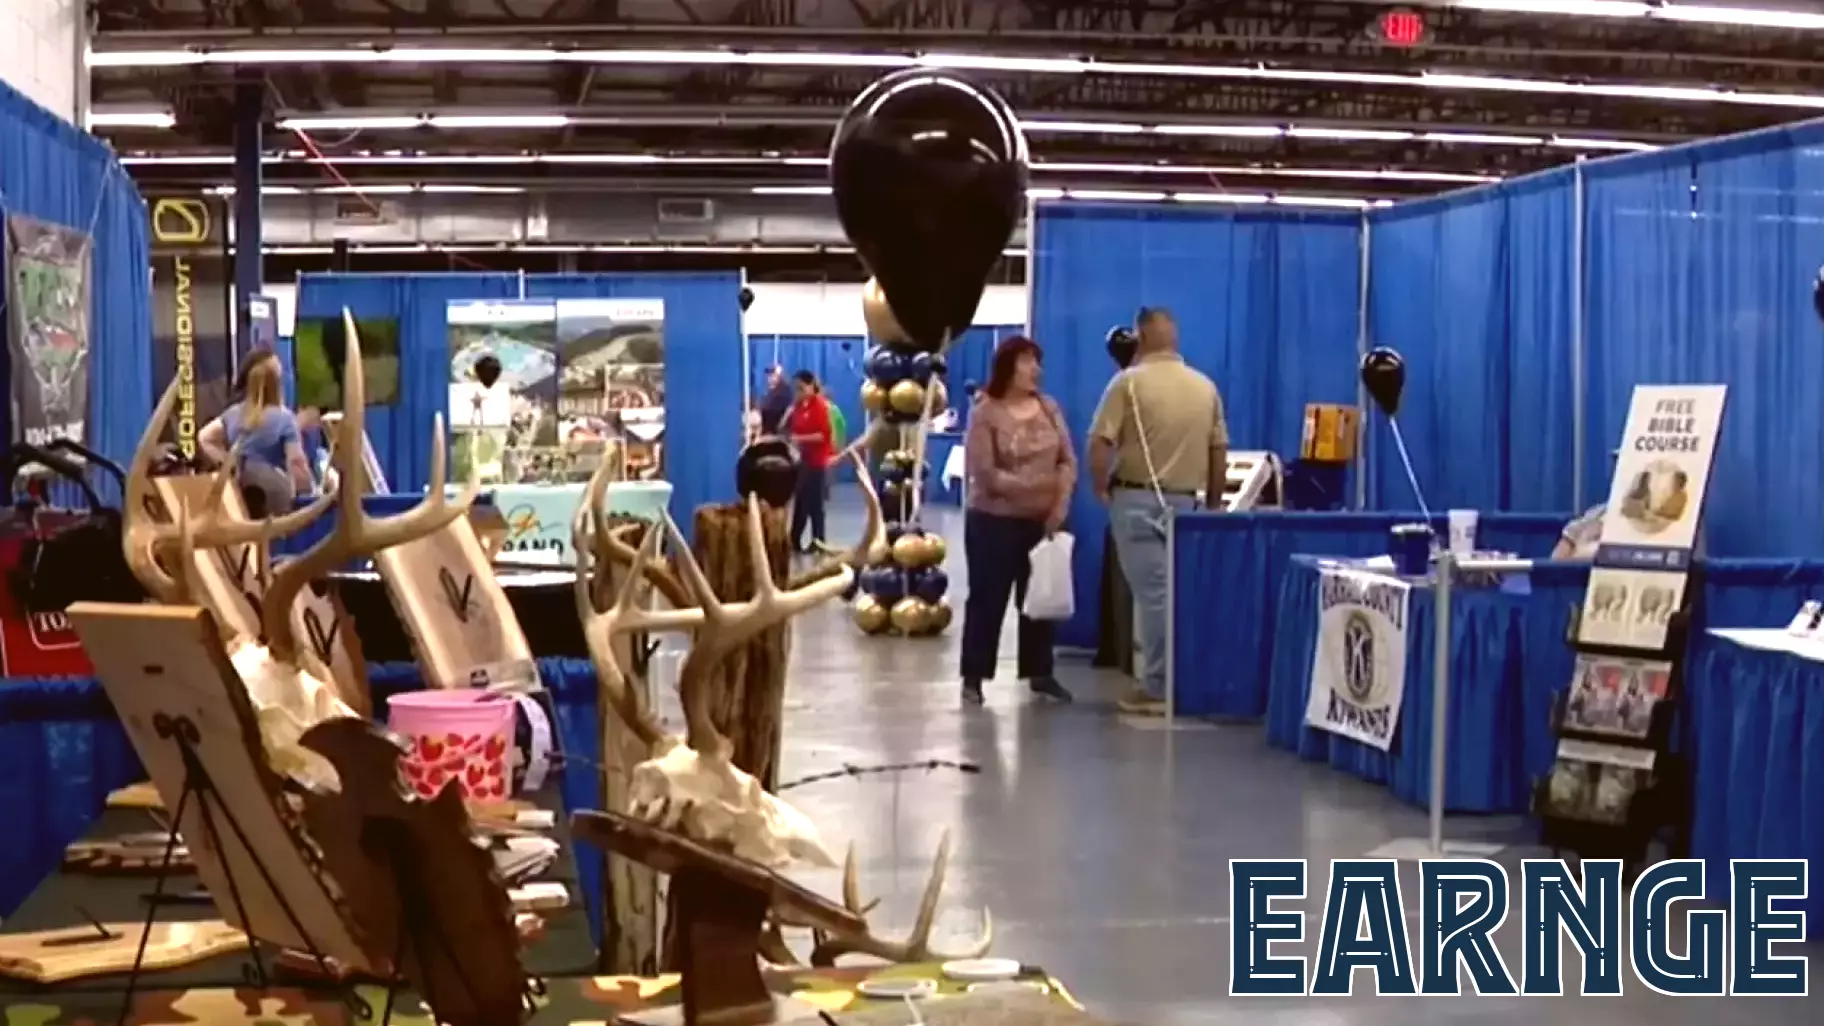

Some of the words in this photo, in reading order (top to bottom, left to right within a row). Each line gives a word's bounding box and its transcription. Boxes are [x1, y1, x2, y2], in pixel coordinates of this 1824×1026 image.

[1655, 399, 1696, 413] FREE
[1648, 416, 1696, 434] BIBLE
[1635, 436, 1701, 453] COURSE
